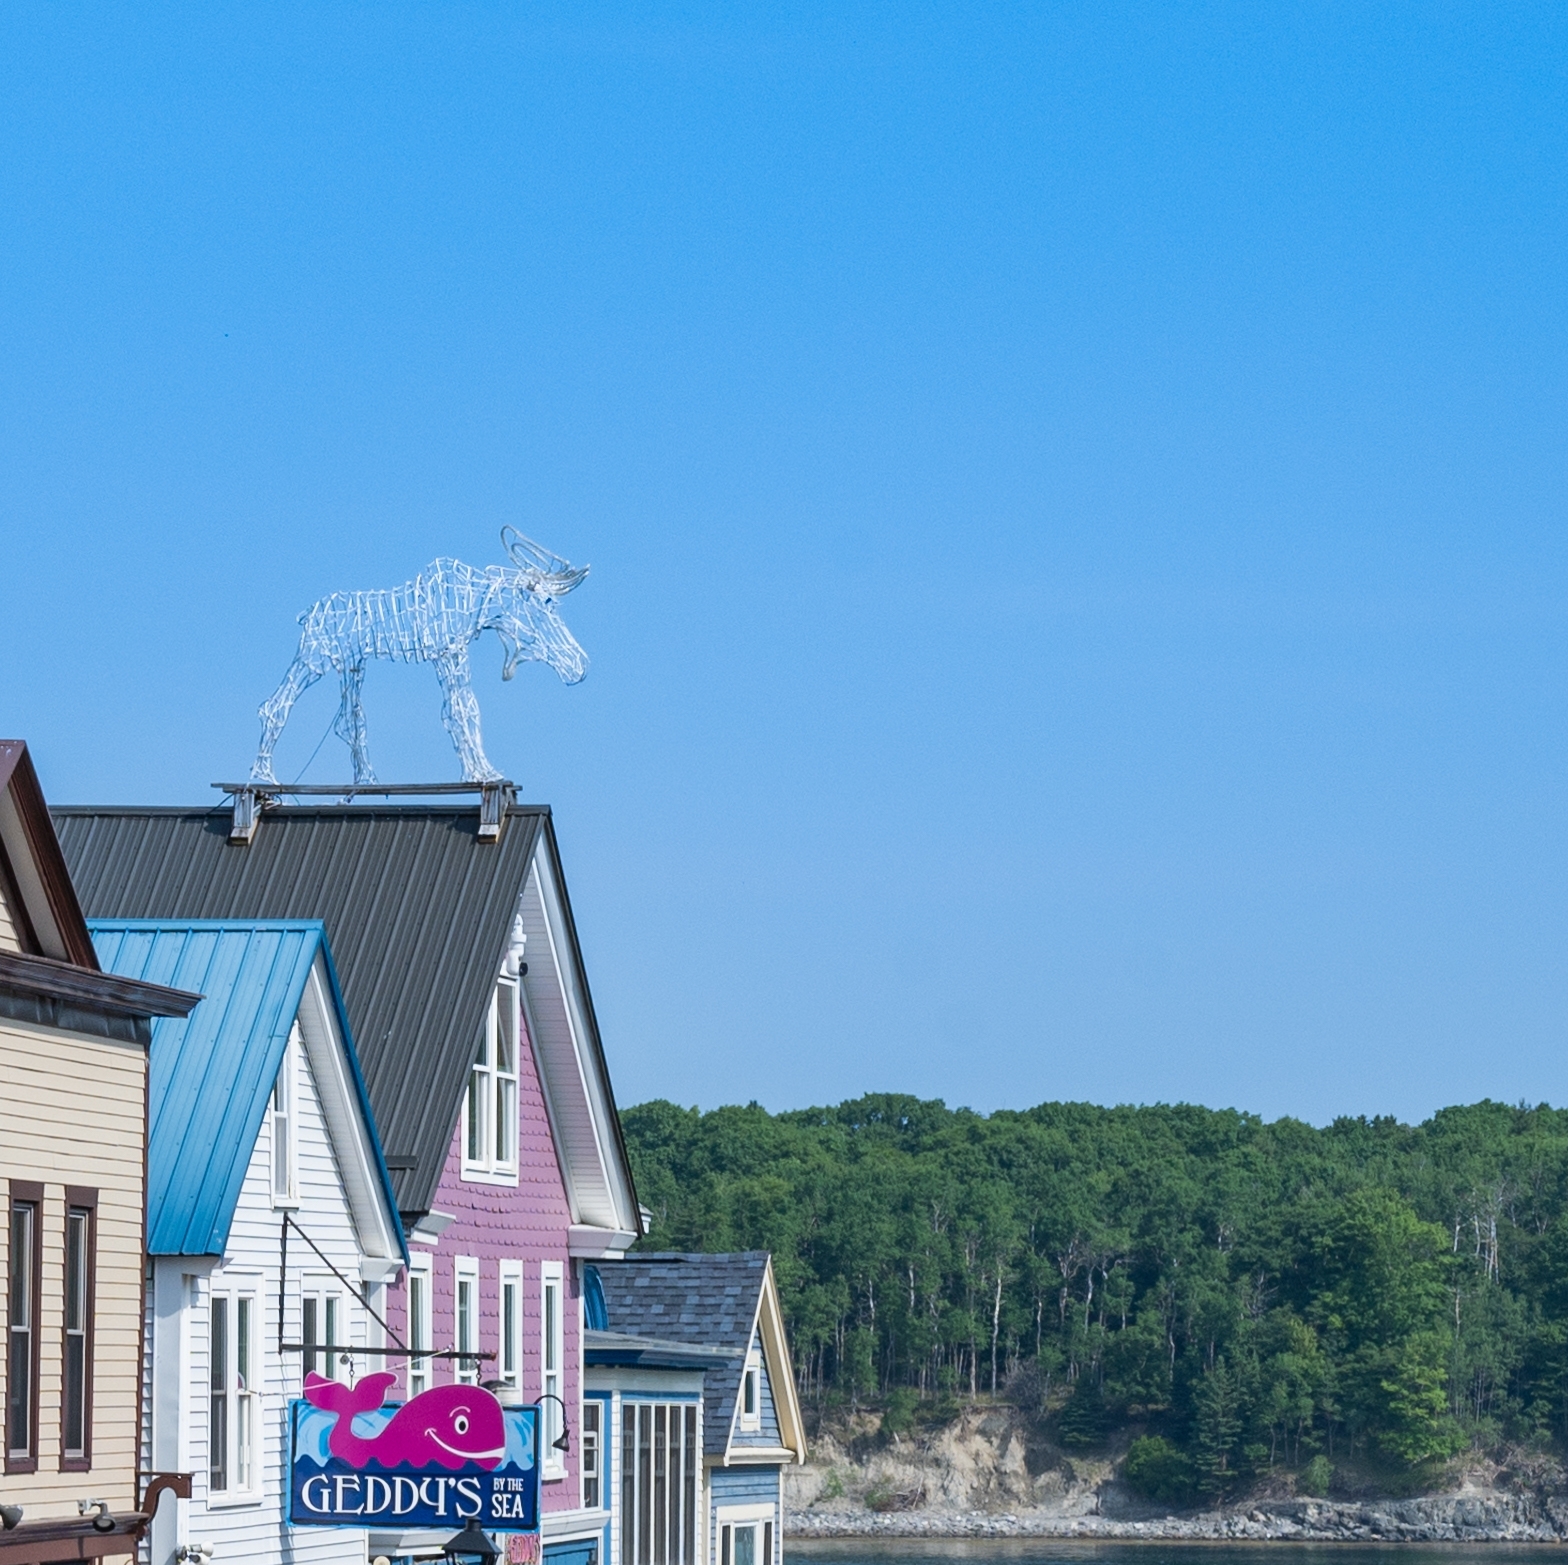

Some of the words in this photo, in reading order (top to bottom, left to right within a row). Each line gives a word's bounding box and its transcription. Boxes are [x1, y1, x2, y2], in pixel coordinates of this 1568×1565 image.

[302, 1473, 482, 1518] GEDDY'S
[493, 1478, 505, 1491] BY
[507, 1478, 524, 1492] THE
[491, 1494, 524, 1519] SEA
